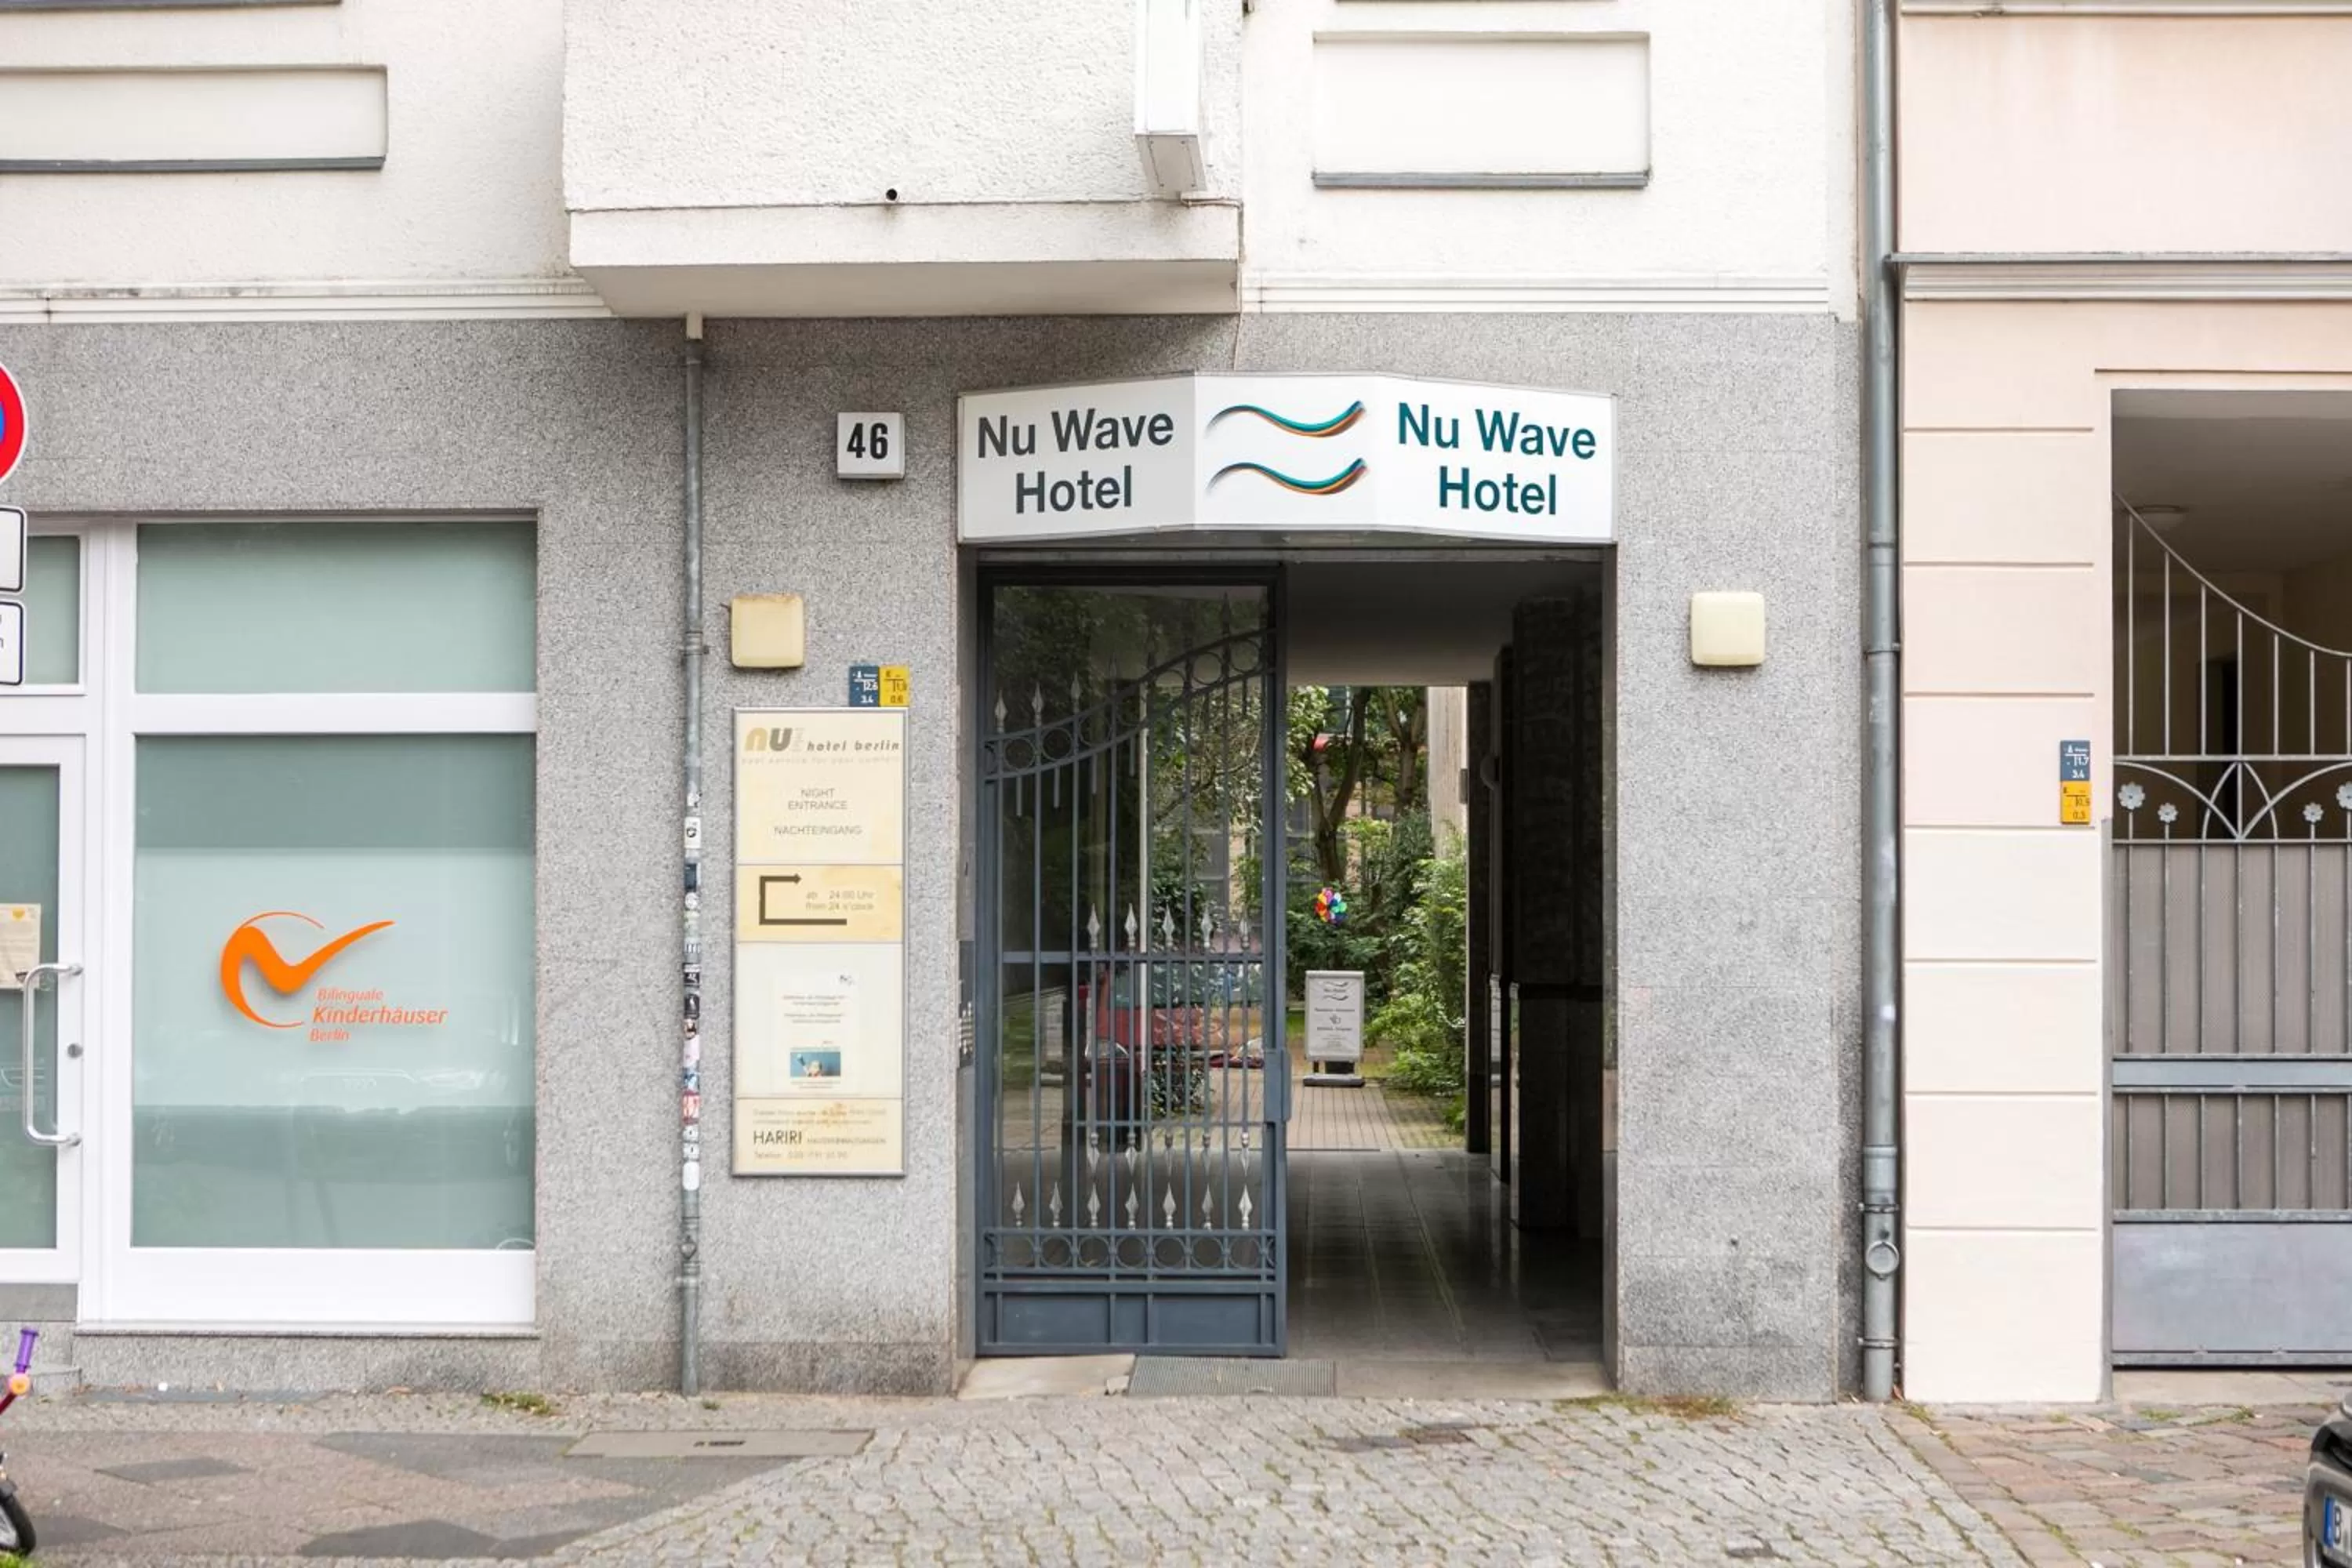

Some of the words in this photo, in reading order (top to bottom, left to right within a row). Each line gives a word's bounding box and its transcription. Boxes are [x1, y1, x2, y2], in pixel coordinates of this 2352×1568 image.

[978, 415, 1036, 459] Nu
[1051, 408, 1174, 452] Wave
[1398, 401, 1460, 448] Nu
[1475, 408, 1596, 460] Wave
[846, 422, 889, 460] 46
[1015, 465, 1132, 514] Hotel
[1439, 465, 1556, 516] Hotel
[807, 740, 848, 752] hotel
[854, 740, 900, 751] berlin
[800, 787, 836, 797] NIGHT
[787, 800, 848, 810] ENTRANCE
[774, 825, 863, 835] NACHTEINGANG
[317, 987, 384, 1004] Bilinguale
[313, 1004, 449, 1025] Kinderhäuser
[310, 1028, 350, 1042] Berlin
[753, 1130, 802, 1145] HARIRI
